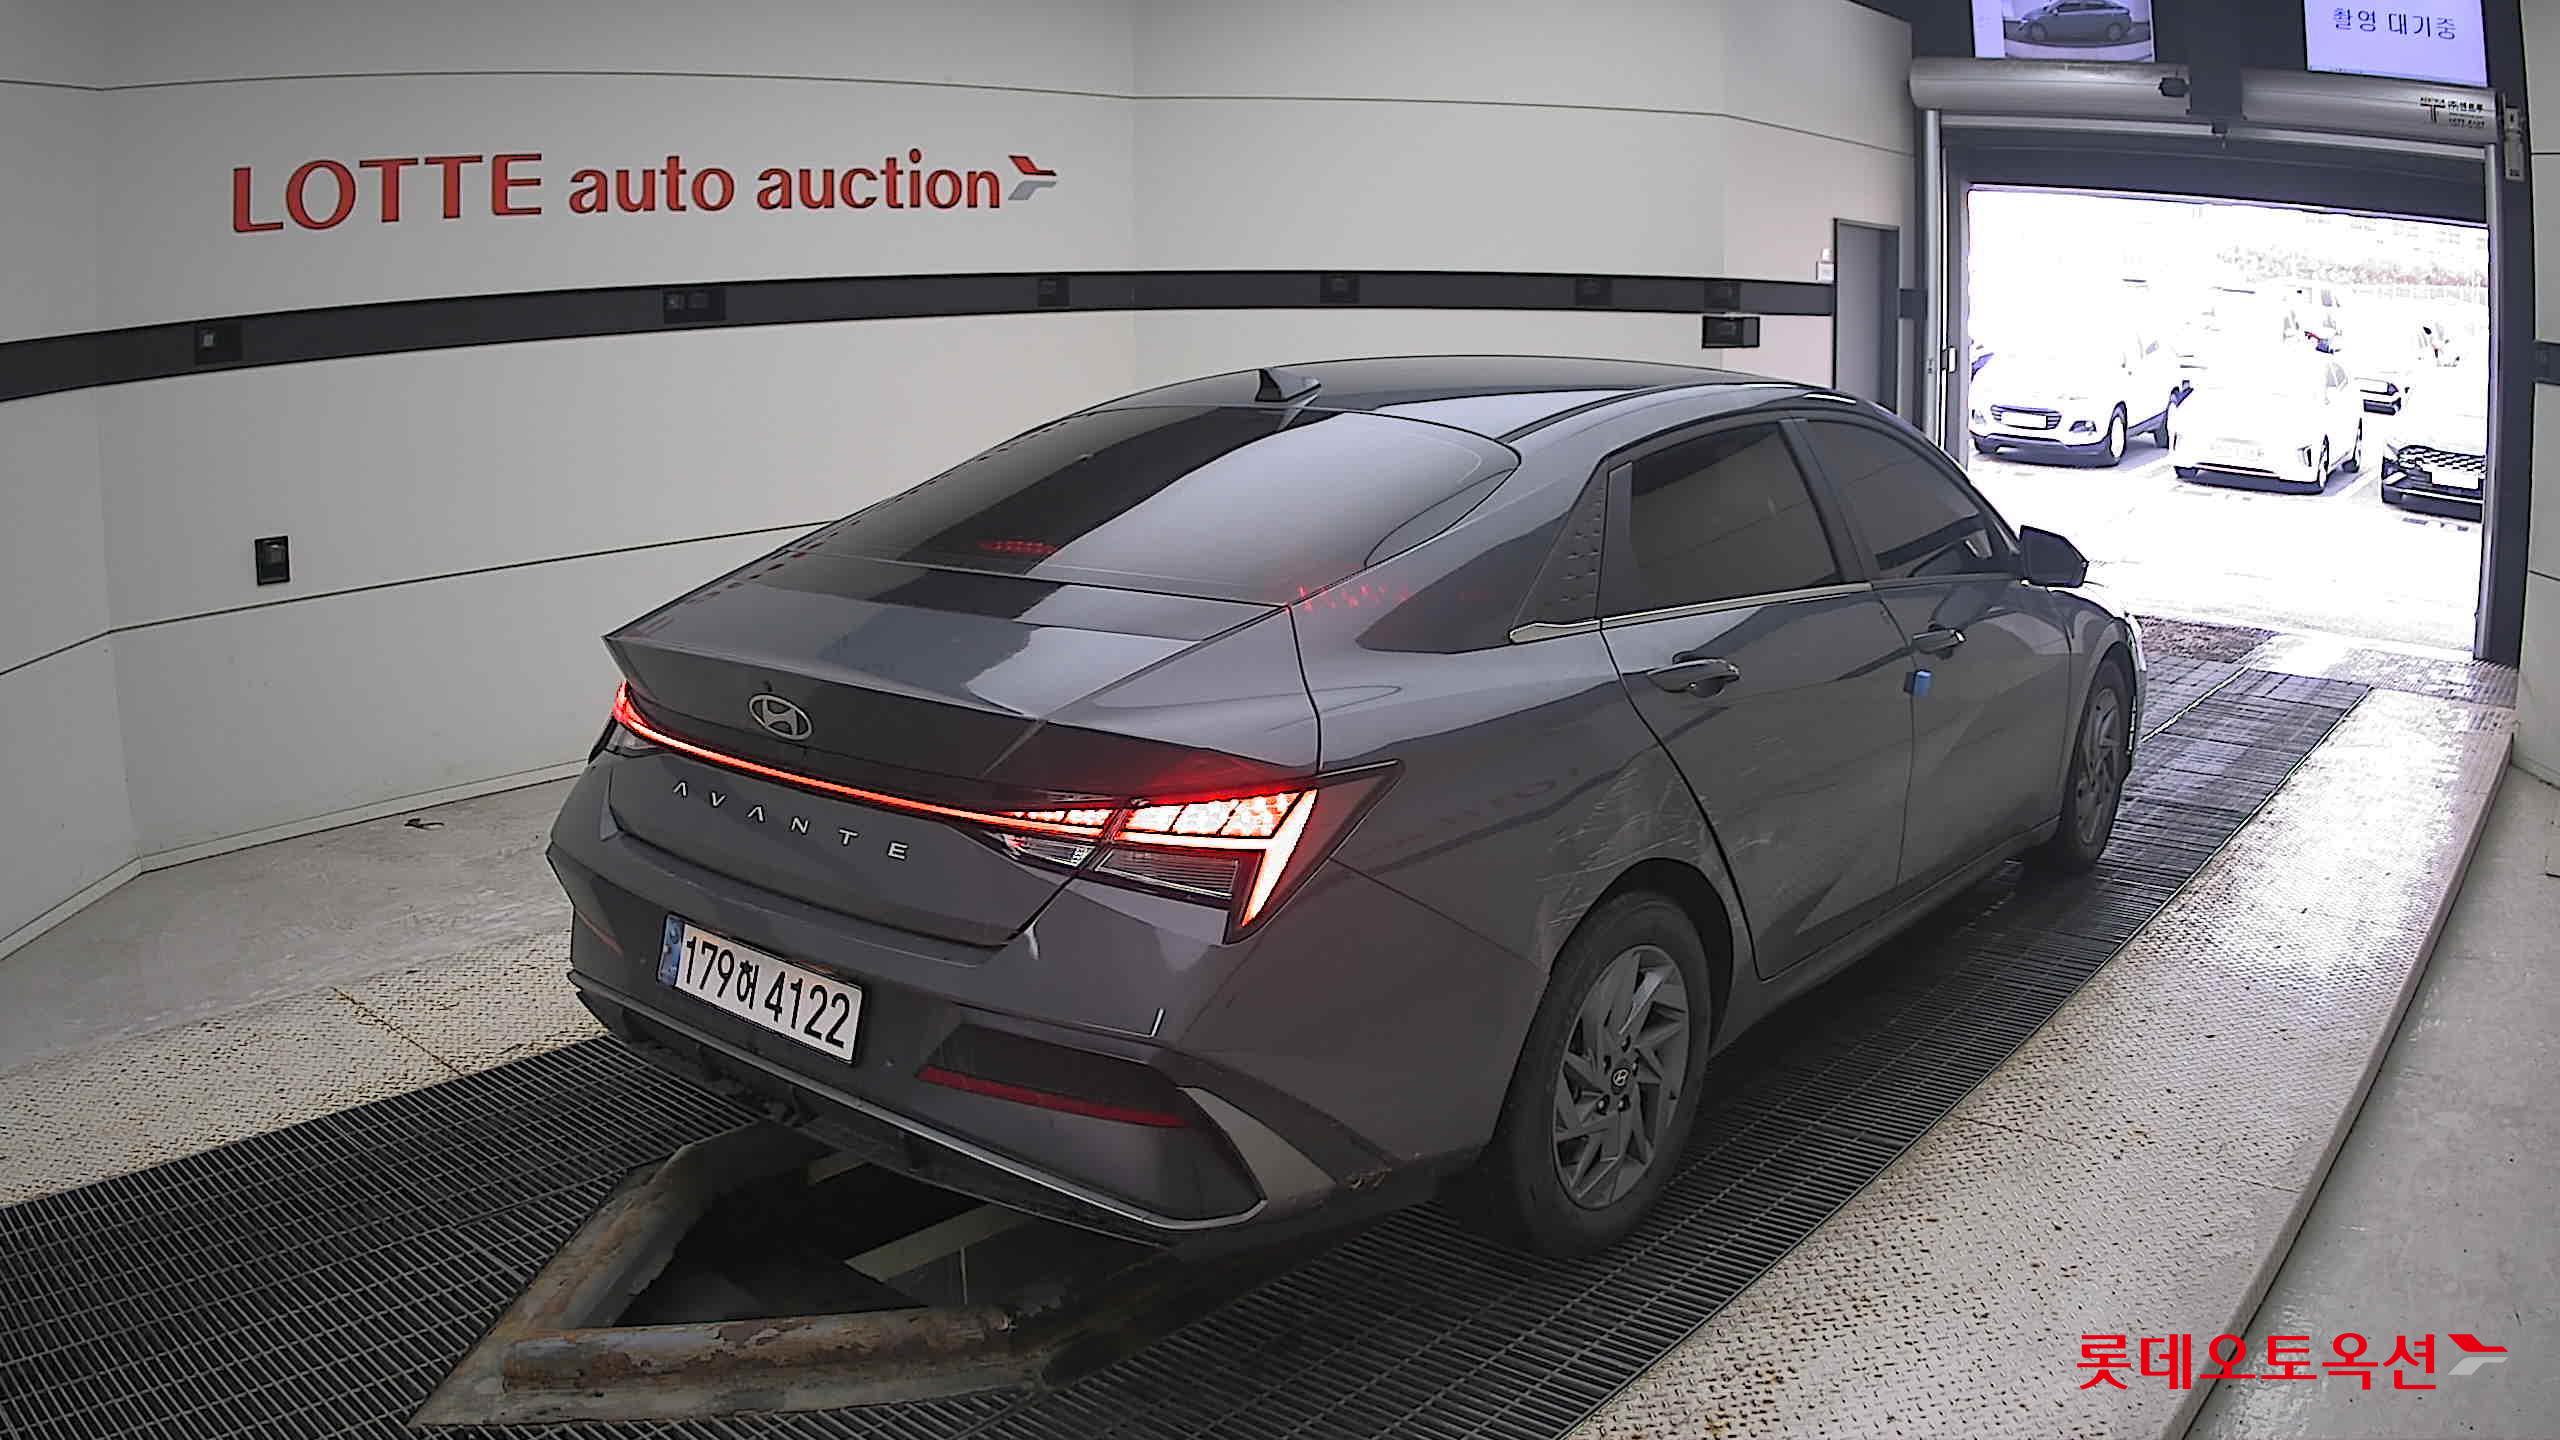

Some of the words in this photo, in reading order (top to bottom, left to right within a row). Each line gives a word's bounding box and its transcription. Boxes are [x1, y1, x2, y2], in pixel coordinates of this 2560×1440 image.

[2333, 7, 2377, 33] 촬영
[2387, 13, 2457, 41] 대기중
[233, 152, 542, 232] LOTTE
[568, 155, 735, 213] auto
[756, 148, 1000, 210] auction
[673, 781, 908, 860] AVANTE
[764, 971, 851, 1049] 4122
